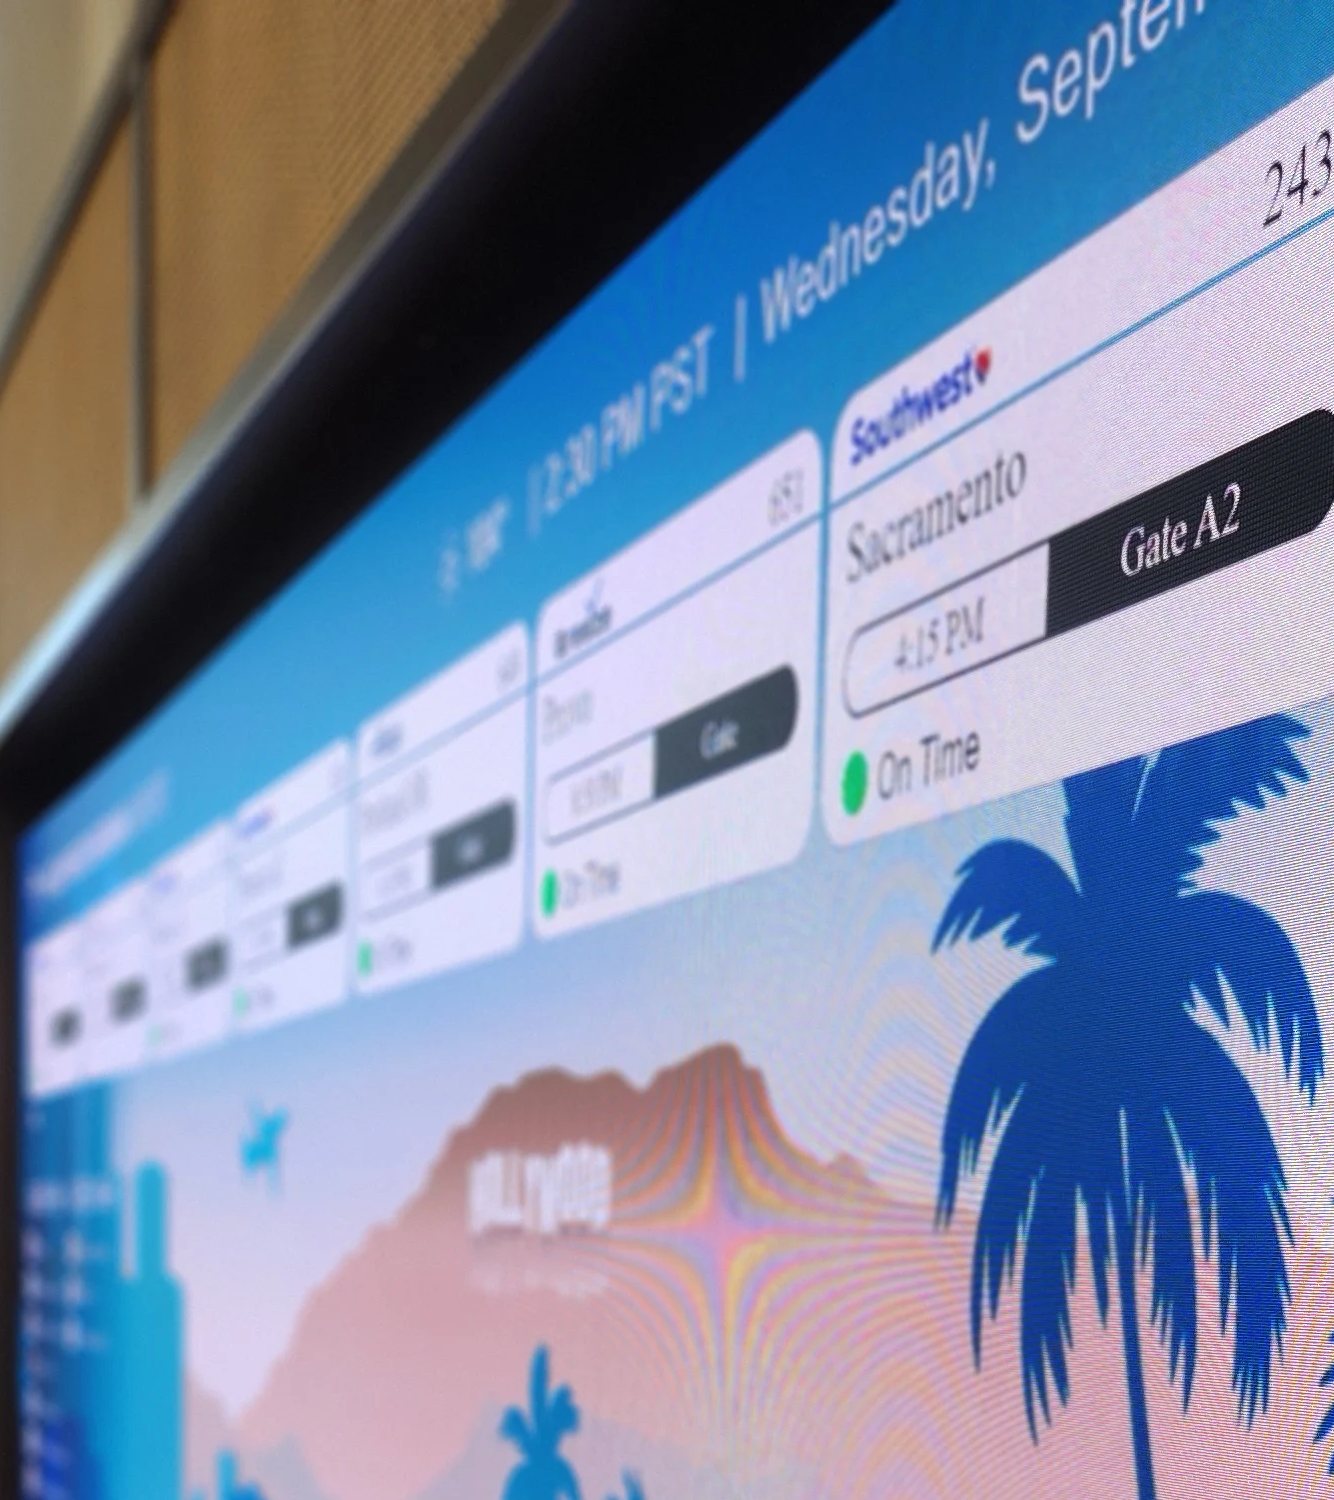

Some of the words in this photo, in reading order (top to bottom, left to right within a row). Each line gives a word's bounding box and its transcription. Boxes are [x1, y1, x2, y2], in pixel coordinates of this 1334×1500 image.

[601, 382, 646, 472] PM
[649, 322, 715, 433] PST
[760, 117, 997, 343] Wednesday,
[850, 347, 975, 466] Southwest
[846, 447, 1028, 583] Sacramento
[1120, 504, 1187, 577] Gate
[1193, 481, 1242, 552] A2
[893, 620, 939, 675] 4:15
[946, 598, 985, 661] PM
[878, 748, 912, 801] On
[920, 730, 980, 784] Time
